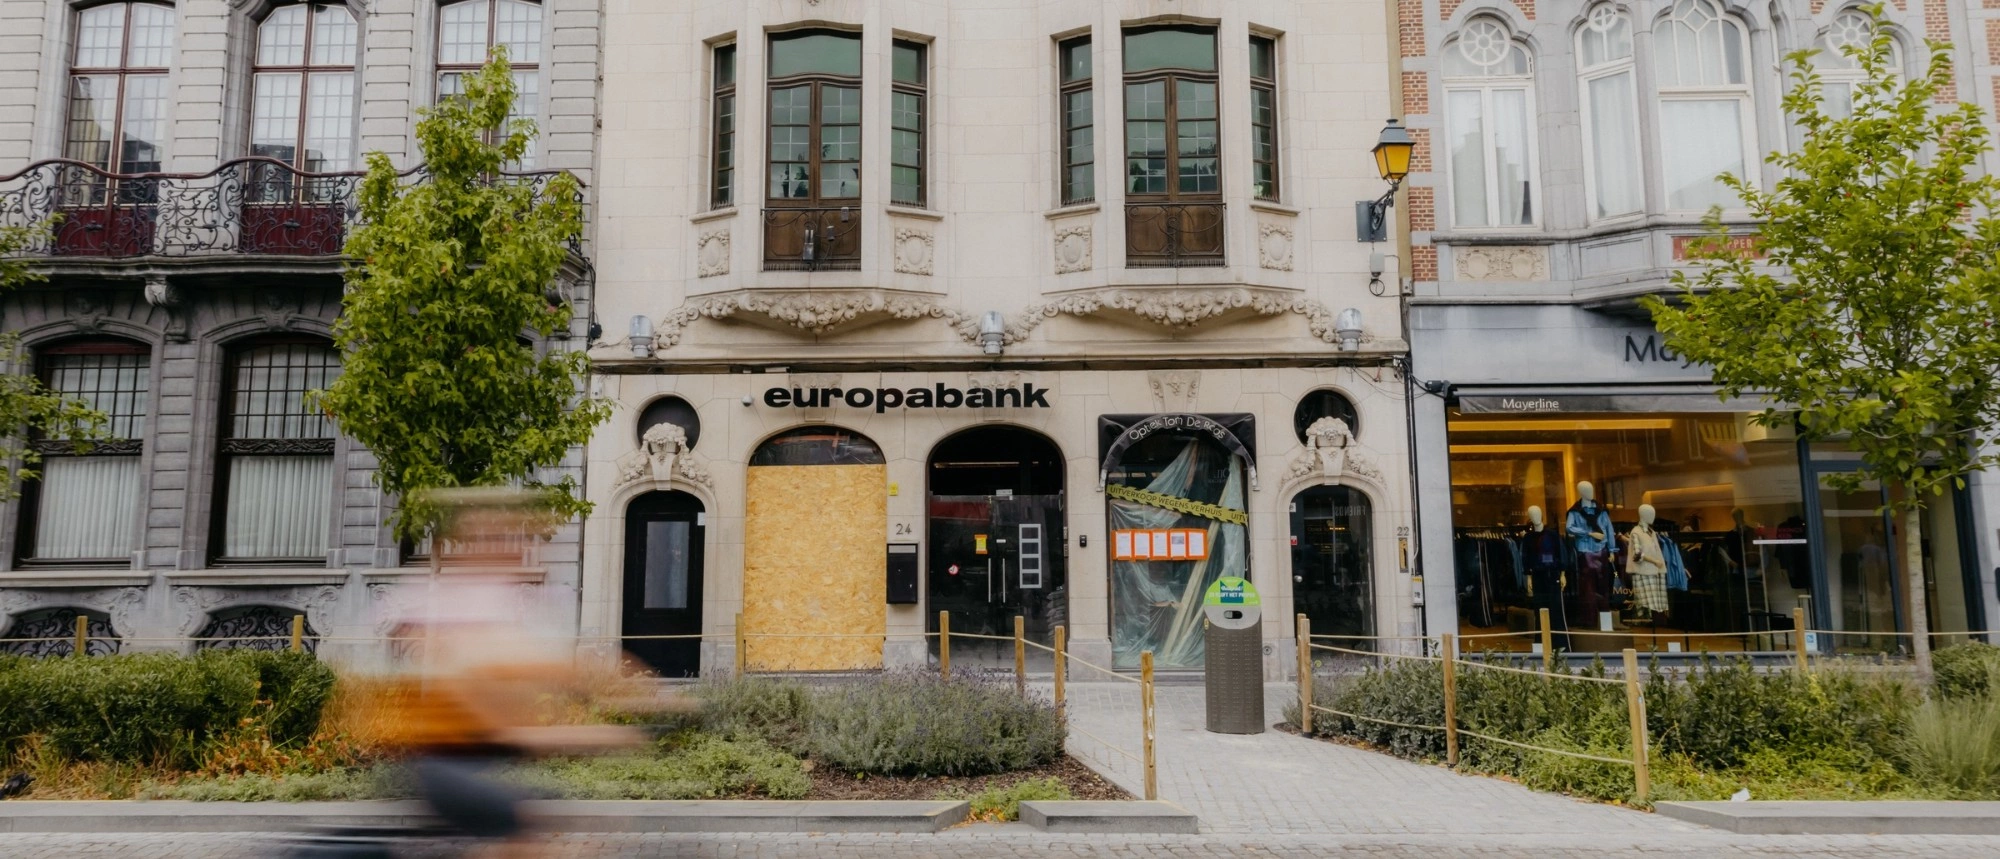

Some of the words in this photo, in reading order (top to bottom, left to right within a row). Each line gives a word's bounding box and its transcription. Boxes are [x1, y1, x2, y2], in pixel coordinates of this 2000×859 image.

[763, 382, 1050, 414] europabank
[1502, 397, 1560, 411] Mayerline
[1163, 416, 1183, 427] Tom
[1186, 416, 1201, 427] De
[1110, 484, 1158, 502] UITVERKOOP
[1158, 495, 1189, 510] WEGENS
[1190, 502, 1222, 517] VERHUIS
[895, 523, 912, 535] 24
[1396, 526, 1410, 537] 22
